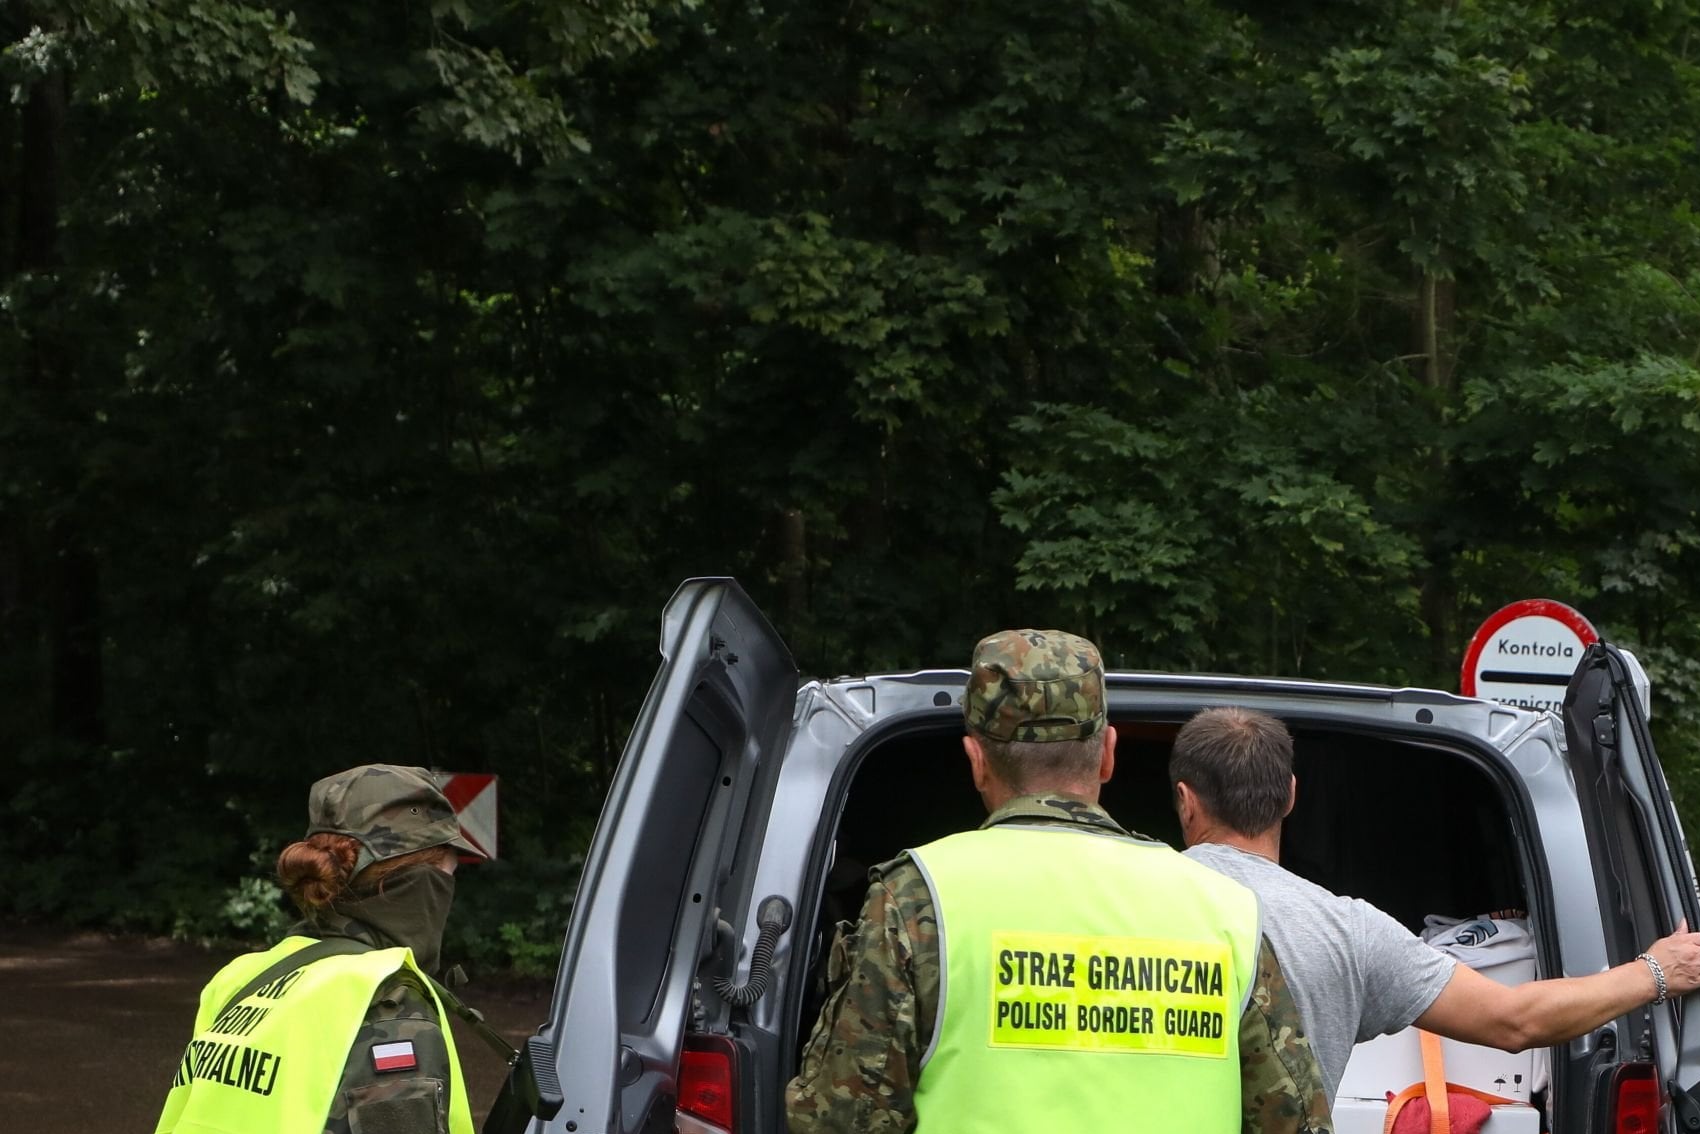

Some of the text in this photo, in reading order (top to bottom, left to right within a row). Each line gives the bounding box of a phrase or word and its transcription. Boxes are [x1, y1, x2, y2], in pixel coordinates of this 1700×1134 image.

[1498, 638, 1574, 658] Kontrola
[1087, 953, 1224, 997] GRANICZNA
[996, 1000, 1224, 1040] POLISH BORDER GUARD
